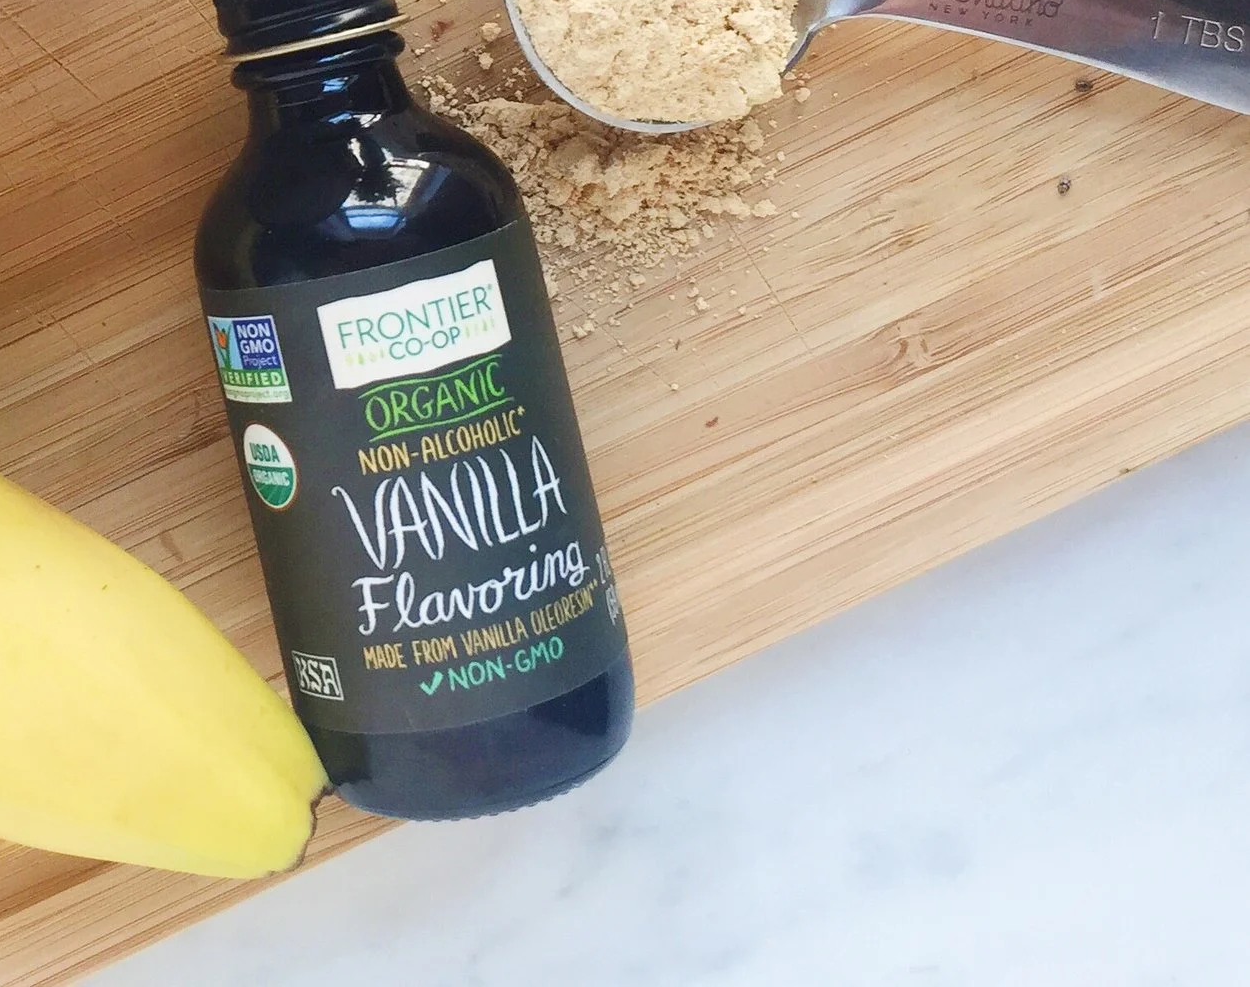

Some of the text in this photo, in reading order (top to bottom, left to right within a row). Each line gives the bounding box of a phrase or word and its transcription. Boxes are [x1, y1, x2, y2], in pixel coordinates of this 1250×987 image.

[929, 2, 1034, 27] NEW YORK
[1151, 11, 1246, 53] 1 TBS
[236, 323, 271, 339] NON
[240, 338, 275, 354] GMO
[388, 326, 461, 360] CO-OP
[243, 355, 279, 369] Project
[364, 361, 506, 432] ORGANIC
[249, 441, 281, 463] USDA
[252, 467, 291, 488] ORGANIC
[331, 435, 568, 570] VANILLA
[351, 541, 591, 637] Flavoring
[363, 642, 407, 670] MADE
[411, 635, 458, 666] FROM
[460, 616, 529, 657] VANILLA
[447, 636, 565, 692] NON-GMO
